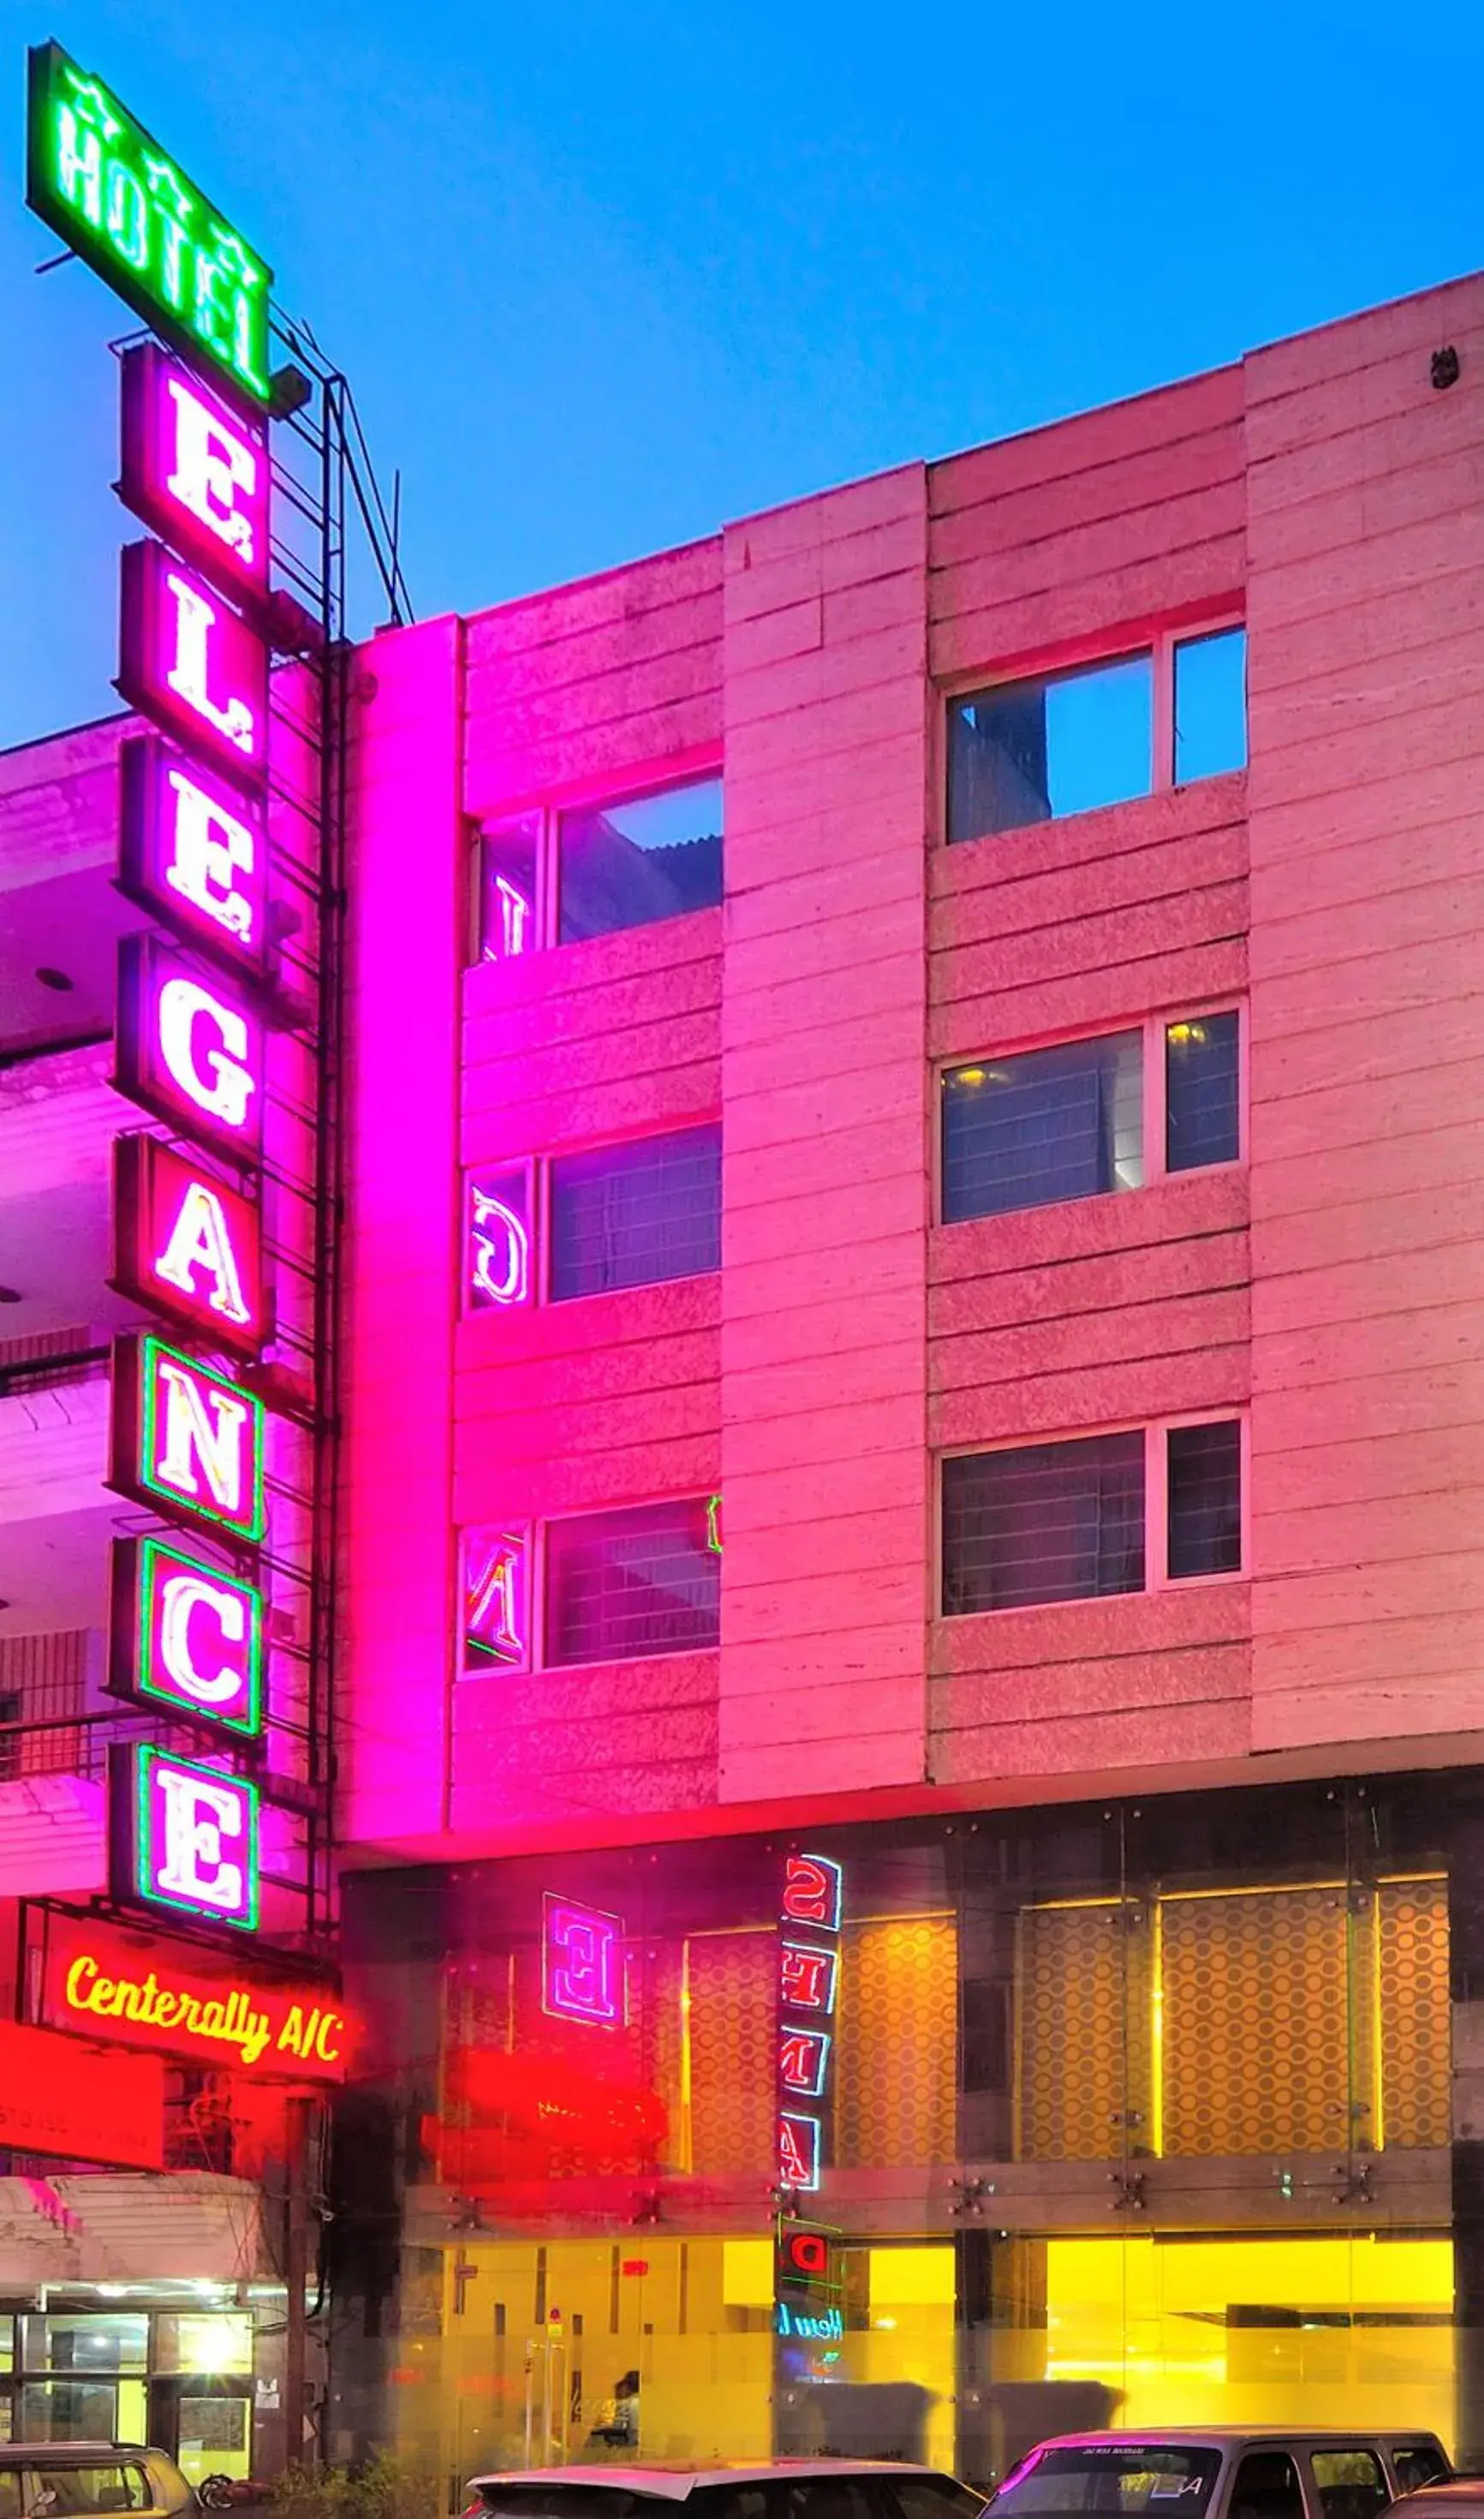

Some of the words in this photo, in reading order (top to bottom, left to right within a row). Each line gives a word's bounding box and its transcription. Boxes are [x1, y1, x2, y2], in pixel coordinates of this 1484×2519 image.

[57, 99, 270, 399] HOTEL
[155, 377, 255, 1910] ELEGANCE
[66, 1956, 271, 2063] Centerally
[277, 2005, 343, 2061] A/C
